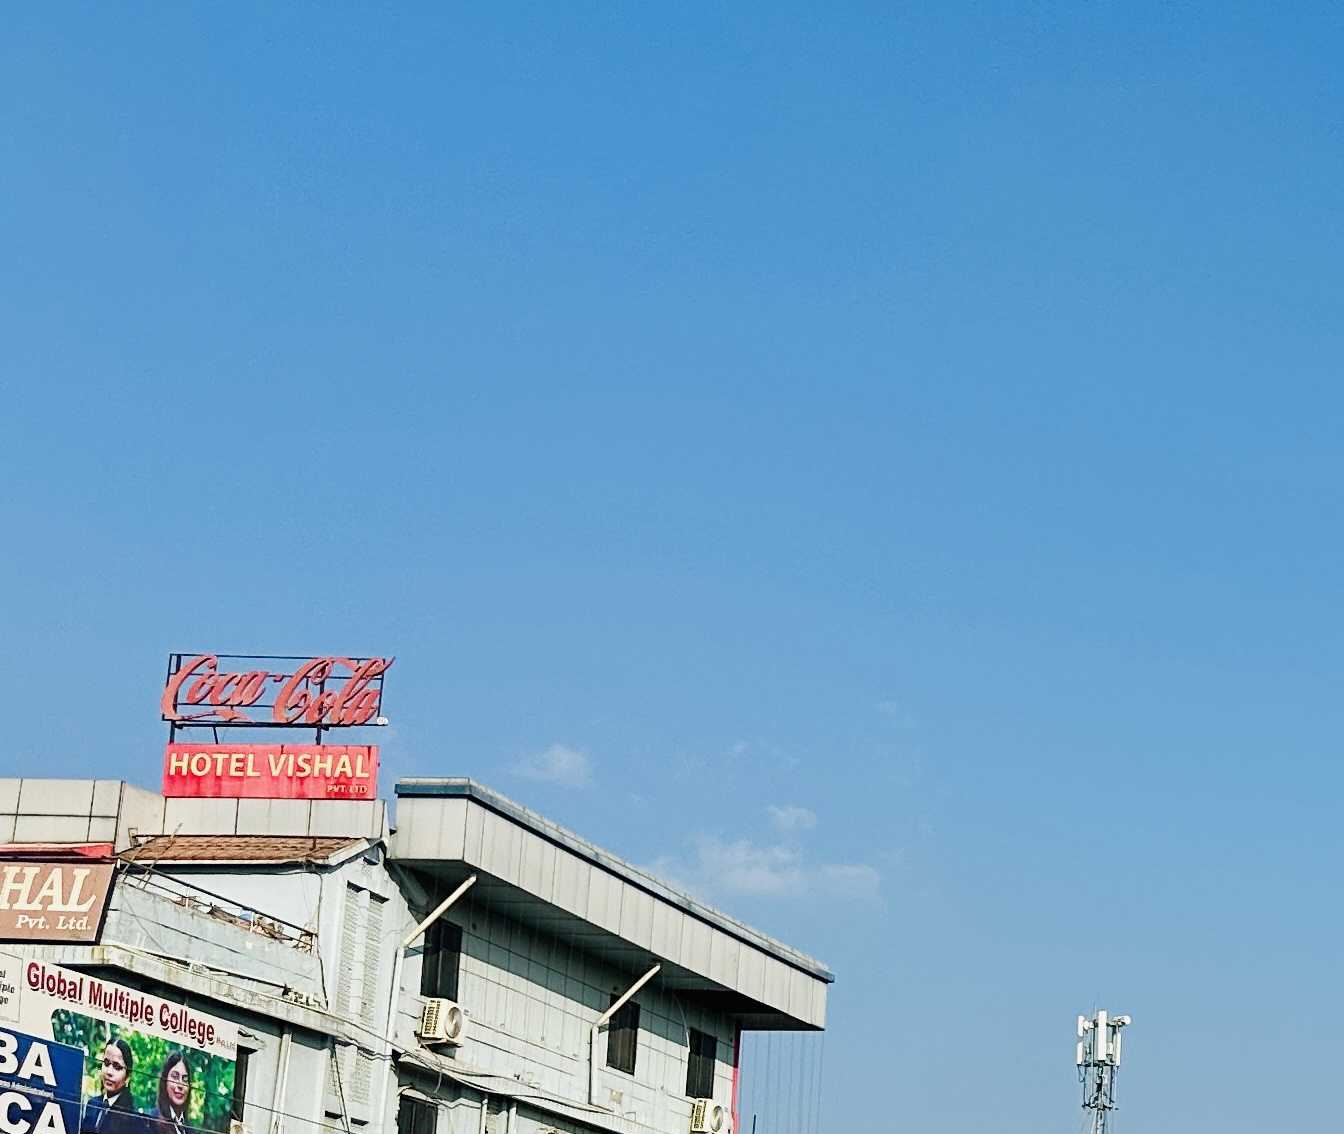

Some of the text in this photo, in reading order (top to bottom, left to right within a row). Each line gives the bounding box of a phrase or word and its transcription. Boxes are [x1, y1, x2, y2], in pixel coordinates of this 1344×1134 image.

[161, 655, 396, 726] Coca-Cola
[168, 752, 370, 779] HOTEL VISHAL
[16, 914, 92, 931] Pvt. Ltd.
[27, 962, 215, 1045] Global Multiple College
